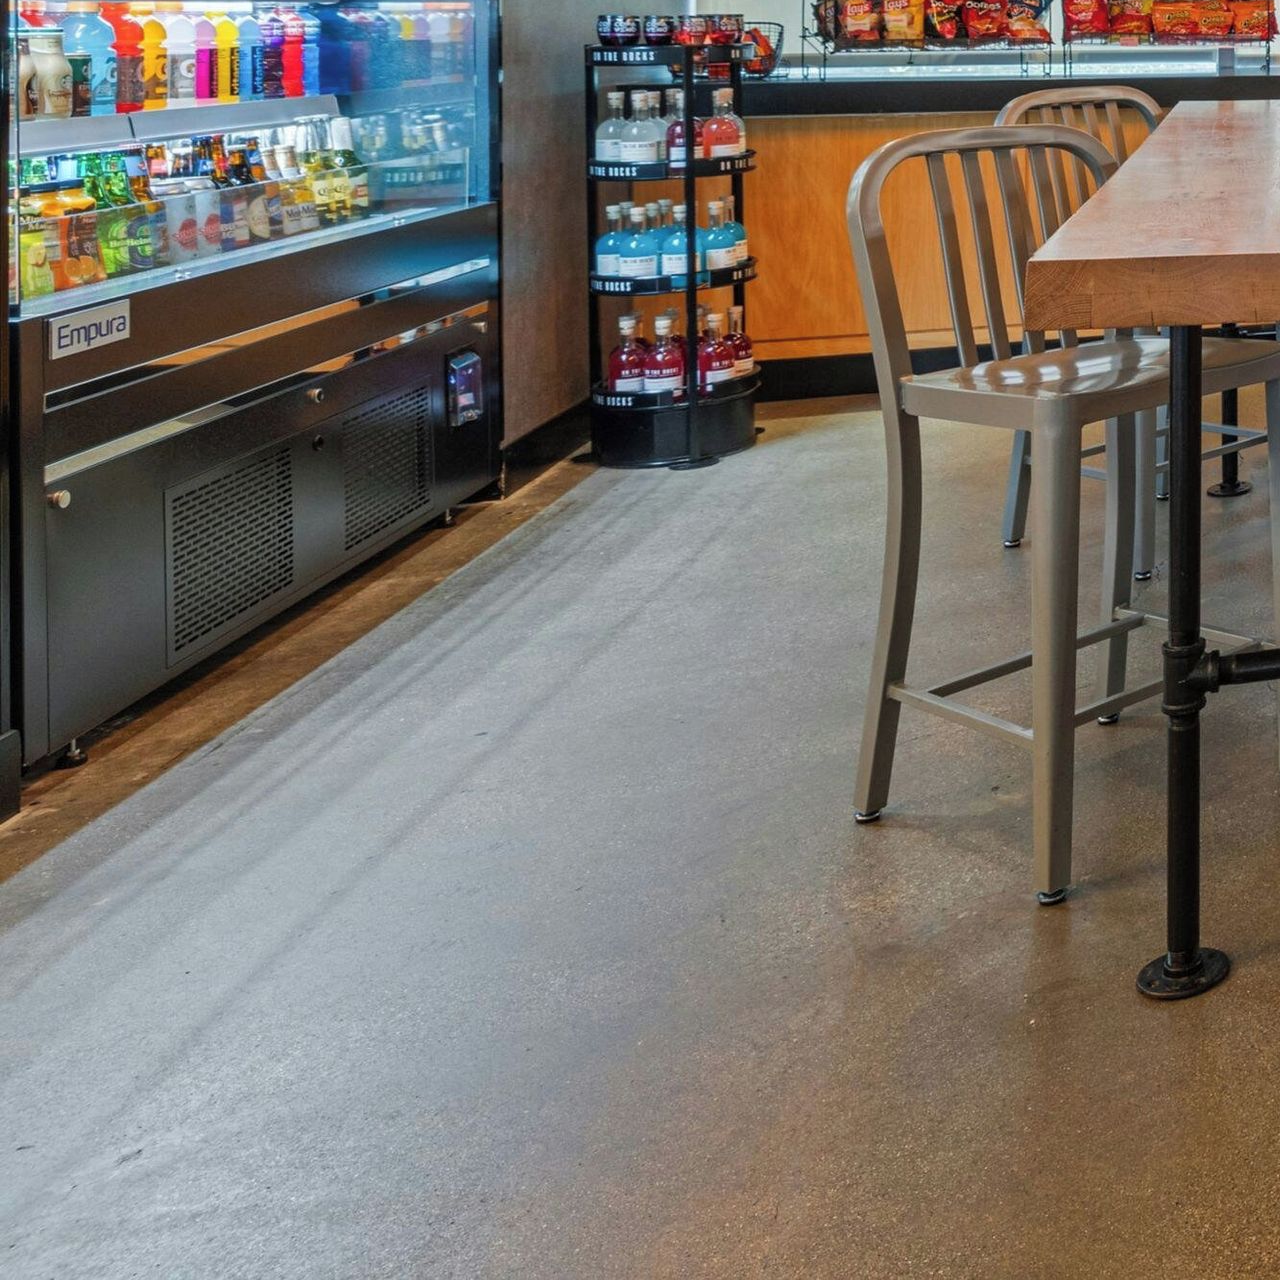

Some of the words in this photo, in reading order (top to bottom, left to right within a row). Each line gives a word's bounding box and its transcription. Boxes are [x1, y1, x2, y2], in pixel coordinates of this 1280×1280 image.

[622, 51, 655, 62] ROCKS
[608, 166, 637, 177] ROCKS
[604, 281, 632, 292] ROCKS
[57, 312, 128, 350] Empura
